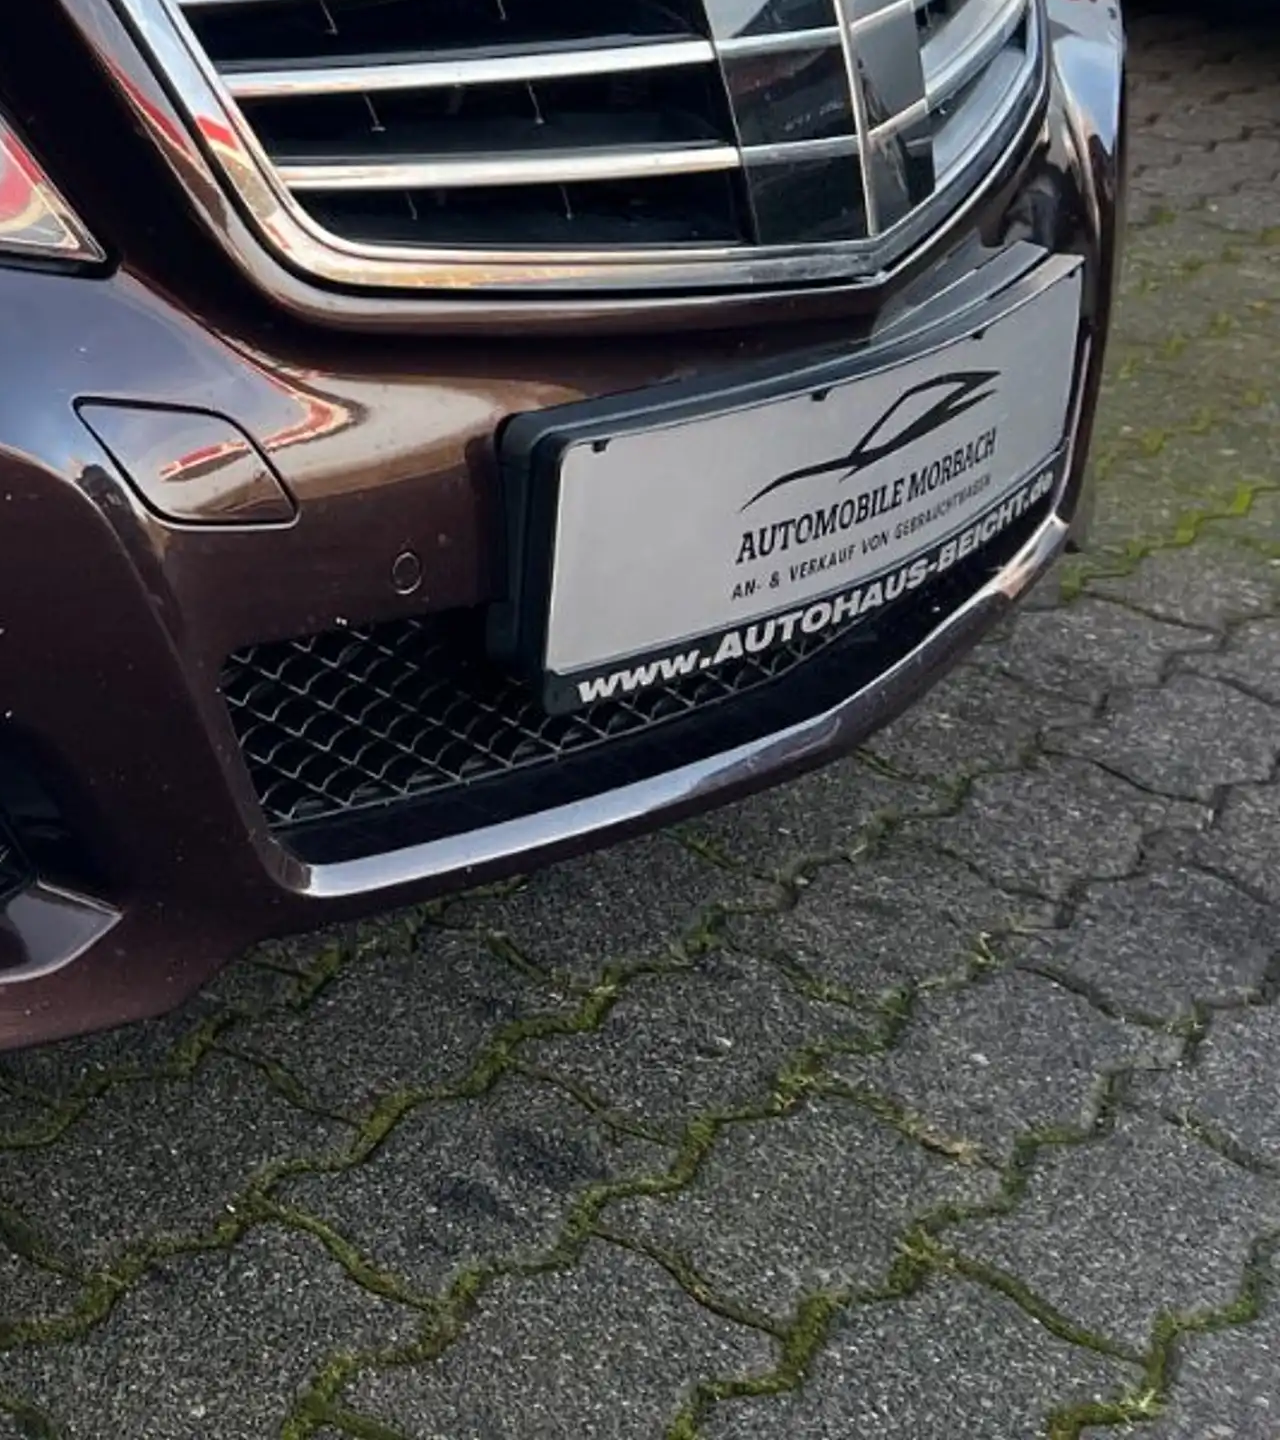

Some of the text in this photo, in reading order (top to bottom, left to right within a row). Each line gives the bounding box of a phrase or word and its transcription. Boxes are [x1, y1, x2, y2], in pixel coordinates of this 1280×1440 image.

[735, 427, 997, 565] AUTOMOBILE MORBACH
[731, 581, 761, 601] AN-
[769, 570, 780, 589] &
[789, 542, 856, 582] VERKAUF
[861, 529, 888, 556] VON
